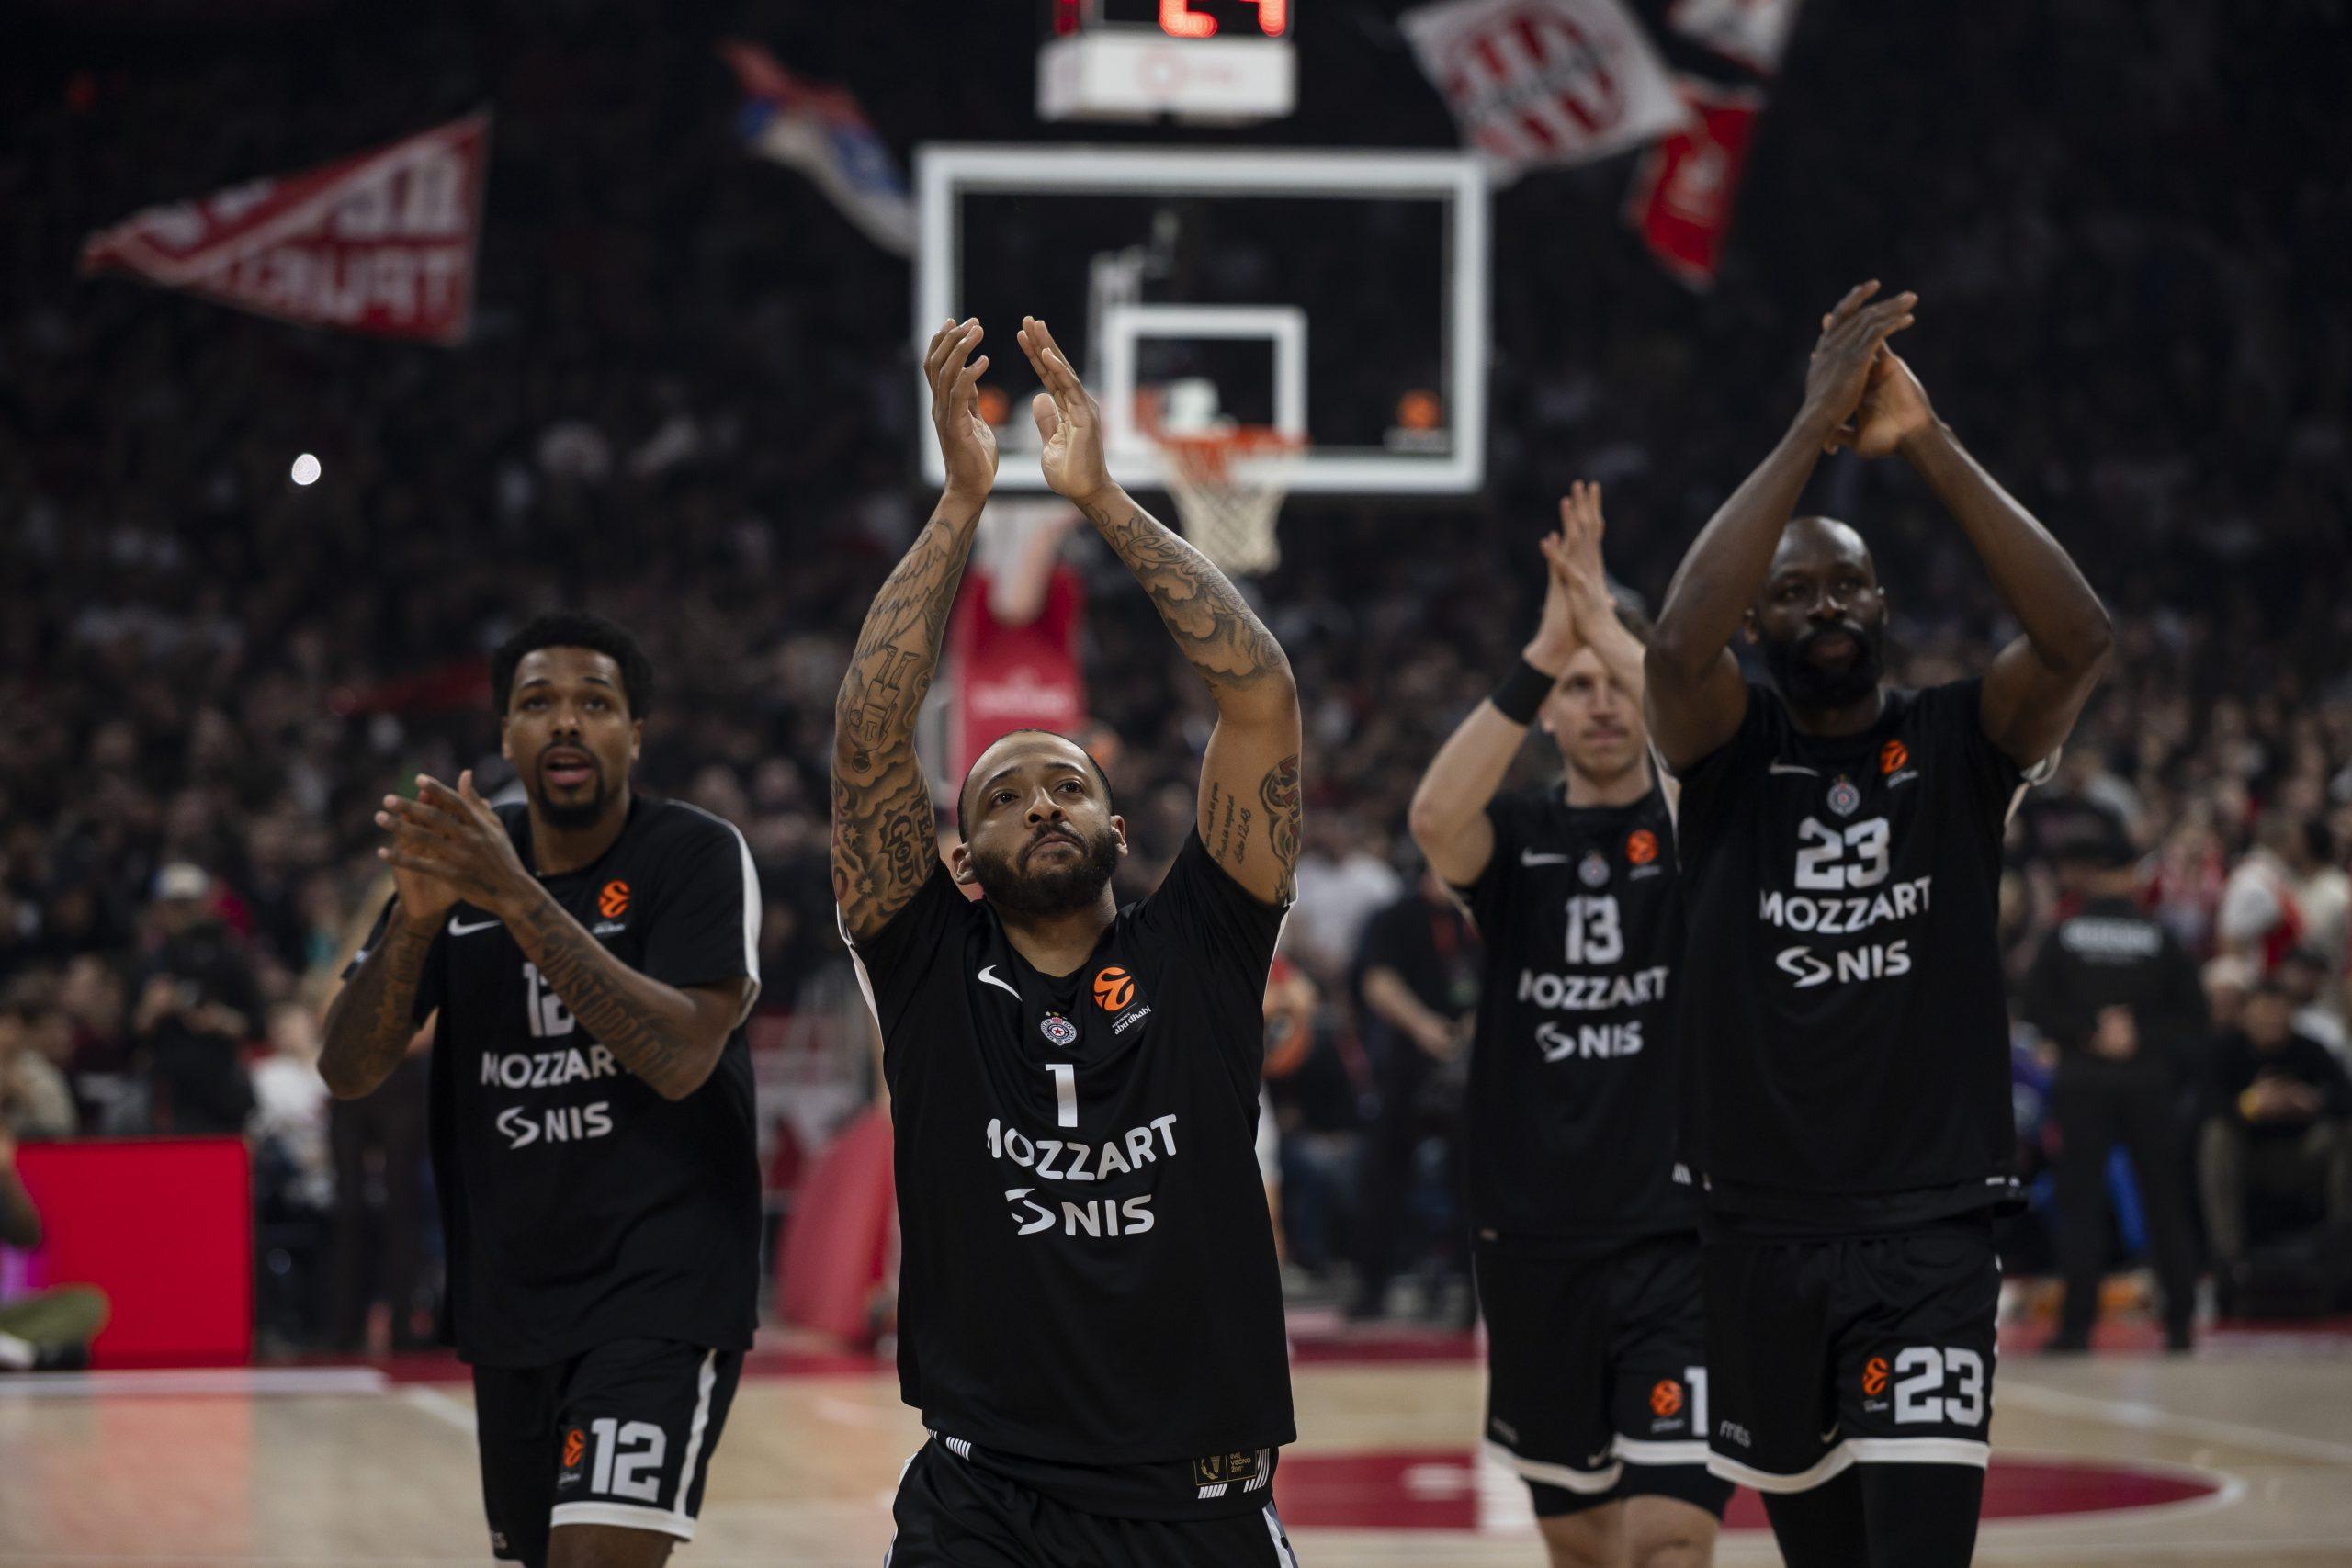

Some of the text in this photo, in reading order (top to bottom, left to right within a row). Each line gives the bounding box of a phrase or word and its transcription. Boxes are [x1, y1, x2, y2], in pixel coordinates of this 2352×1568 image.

[1794, 817, 1890, 890] 23
[1565, 894, 1625, 965] 13
[1758, 875, 1932, 934] MOZZART
[1838, 940, 1911, 984] NIS
[481, 1044, 634, 1089] MOZZAR
[1578, 1021, 1645, 1060] NIS
[545, 1101, 614, 1144] NIS
[1046, 1064, 1078, 1127] 1
[1061, 1194, 1155, 1237] NIS
[1894, 1346, 1984, 1427] 23
[590, 1417, 668, 1504] 12
